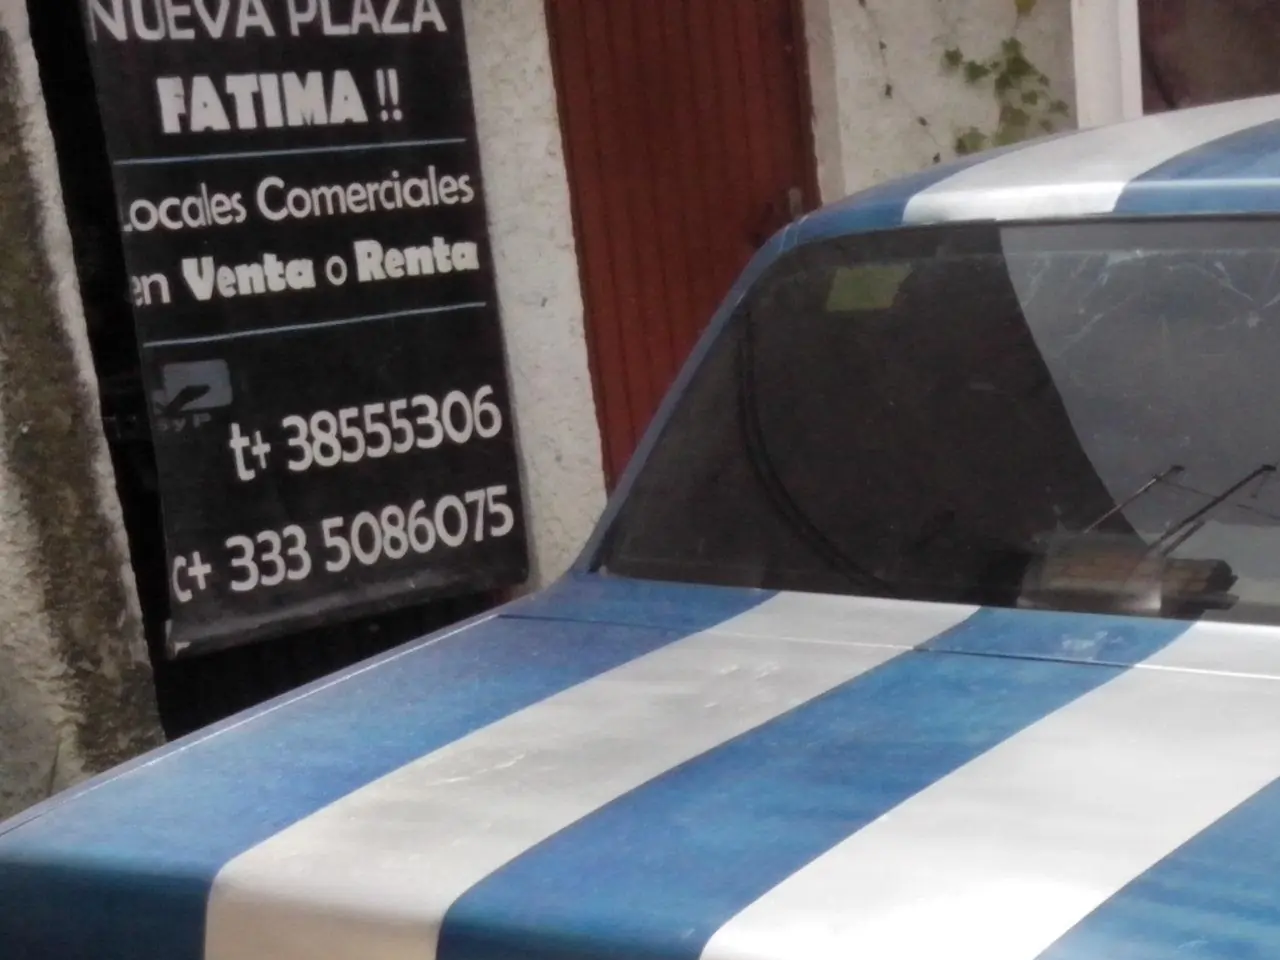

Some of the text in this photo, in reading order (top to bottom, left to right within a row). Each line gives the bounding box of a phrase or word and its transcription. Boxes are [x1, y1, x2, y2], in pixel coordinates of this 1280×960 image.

[86, 0, 448, 41] NUEVA PLAZA
[156, 69, 369, 134] FATIMA
[122, 165, 475, 232] ocales Comerciales
[182, 252, 316, 301] Venta
[325, 255, 349, 285] o
[353, 236, 479, 282] Renta
[282, 385, 502, 471] 38555306
[225, 525, 312, 592] 333
[321, 485, 514, 573] 5086075
